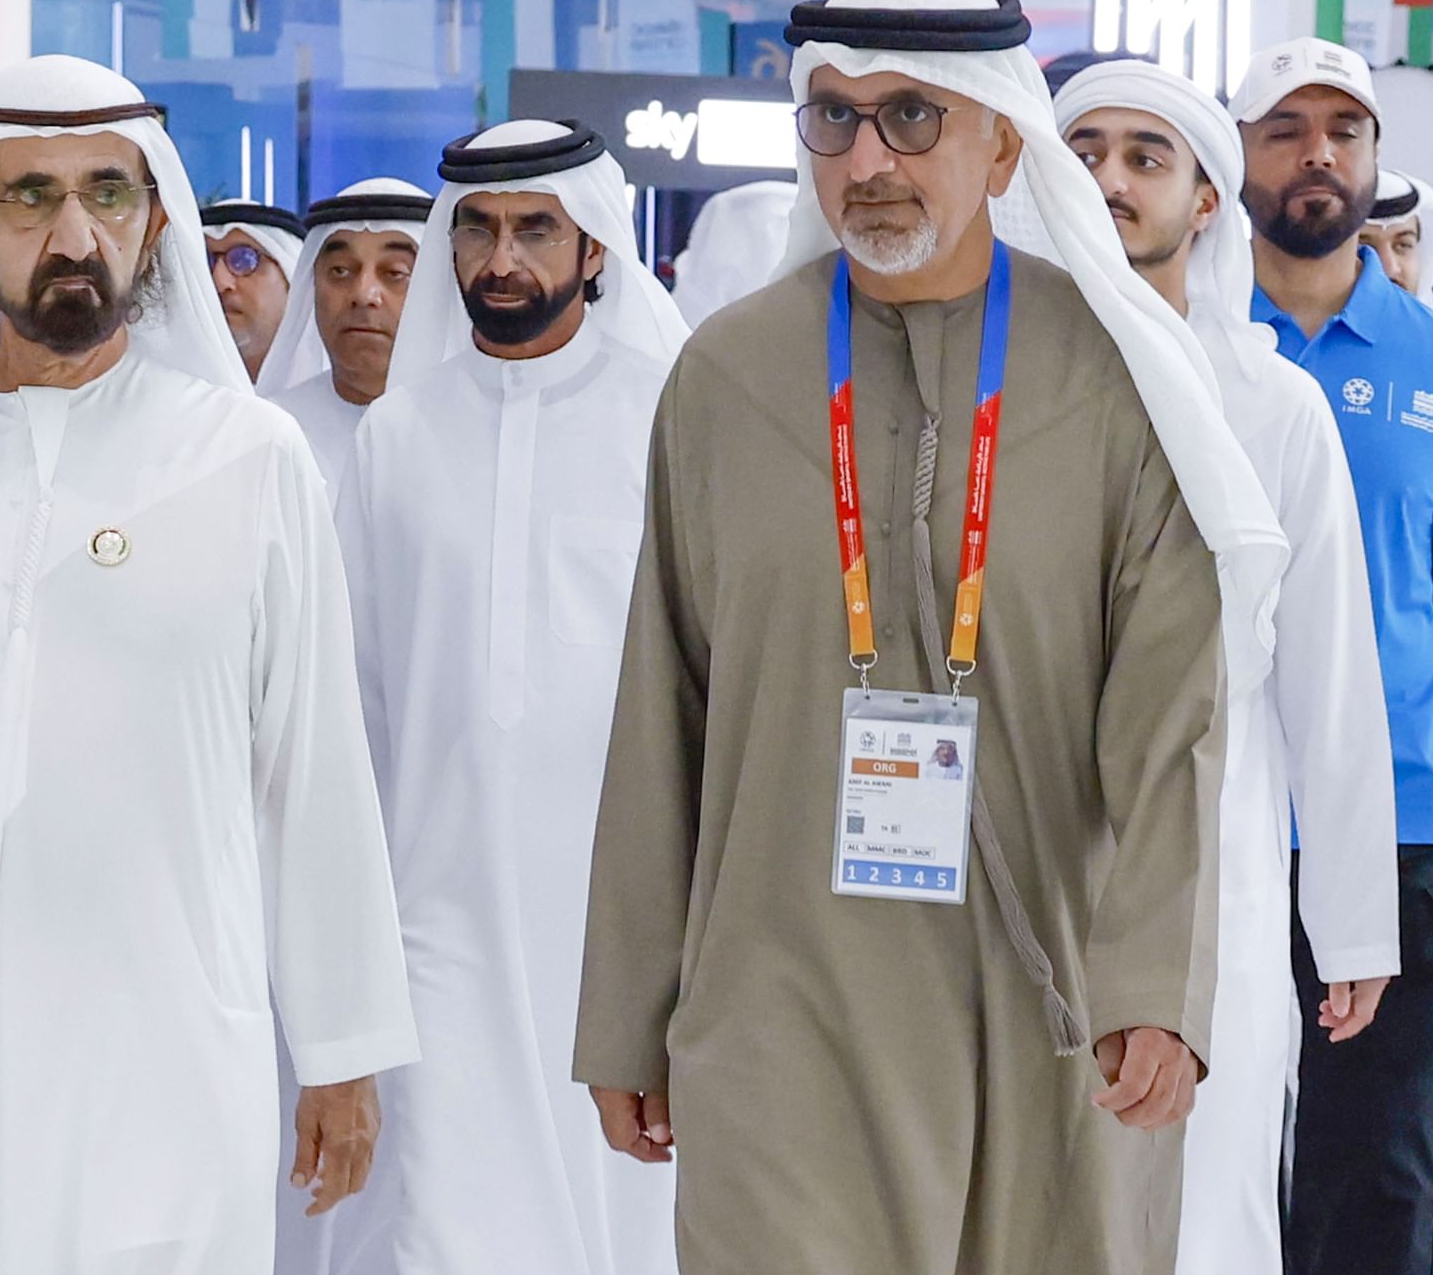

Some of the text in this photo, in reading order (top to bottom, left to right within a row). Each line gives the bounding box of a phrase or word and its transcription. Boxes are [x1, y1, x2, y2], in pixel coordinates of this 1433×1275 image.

[625, 100, 697, 160] sky
[873, 762, 897, 773] ORG
[847, 864, 947, 887] 1 2 3 4 5
